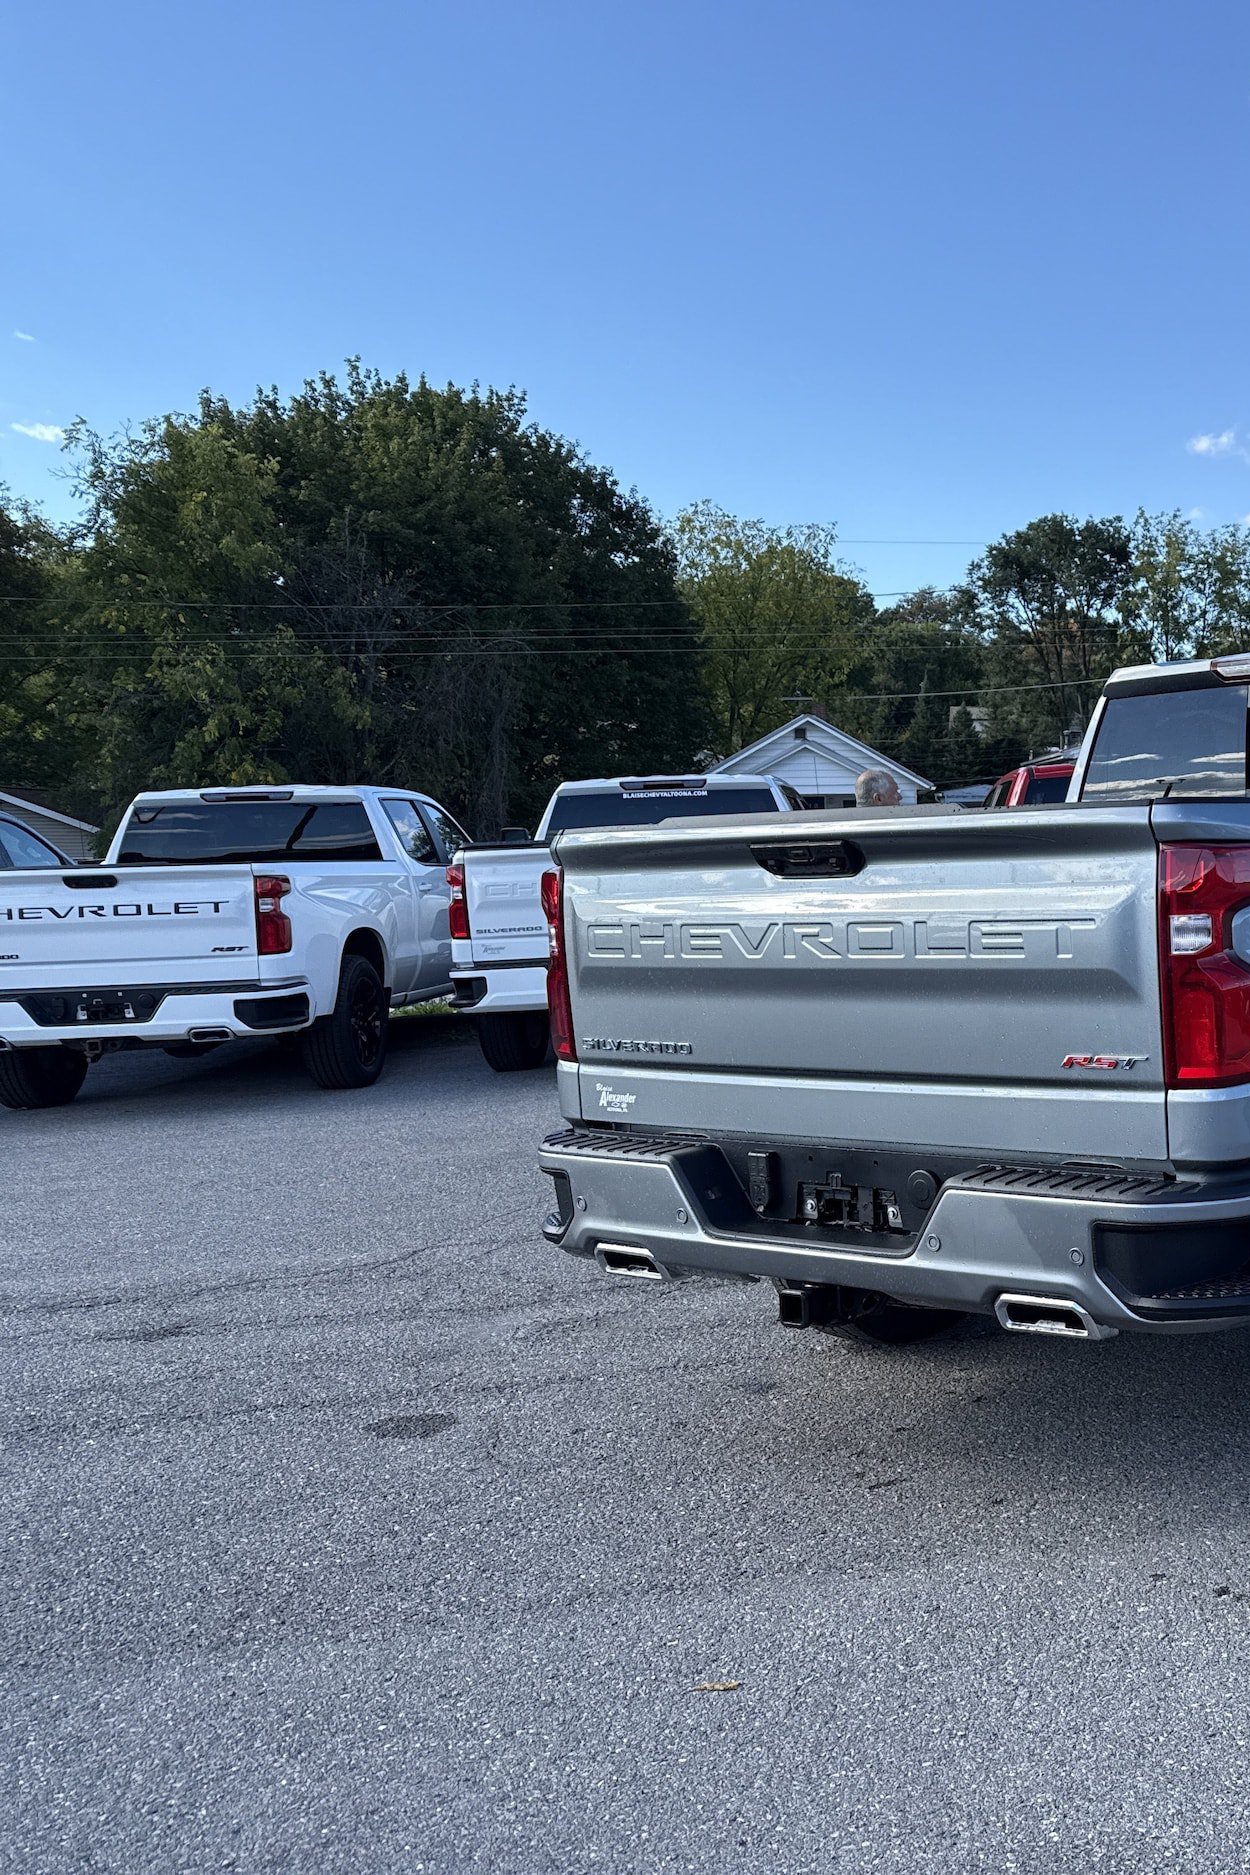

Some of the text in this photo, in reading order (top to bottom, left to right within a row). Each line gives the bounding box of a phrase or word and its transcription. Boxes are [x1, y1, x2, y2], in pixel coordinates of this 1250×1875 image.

[623, 790, 707, 799] BLAISECHEVYALTOONA.COM
[476, 925, 543, 934] SILVERADO
[587, 917, 1097, 959] CHEVROLET
[582, 1038, 693, 1056] SILVERADO
[1060, 1054, 1150, 1070] RST
[599, 1091, 637, 1106] Alexander
